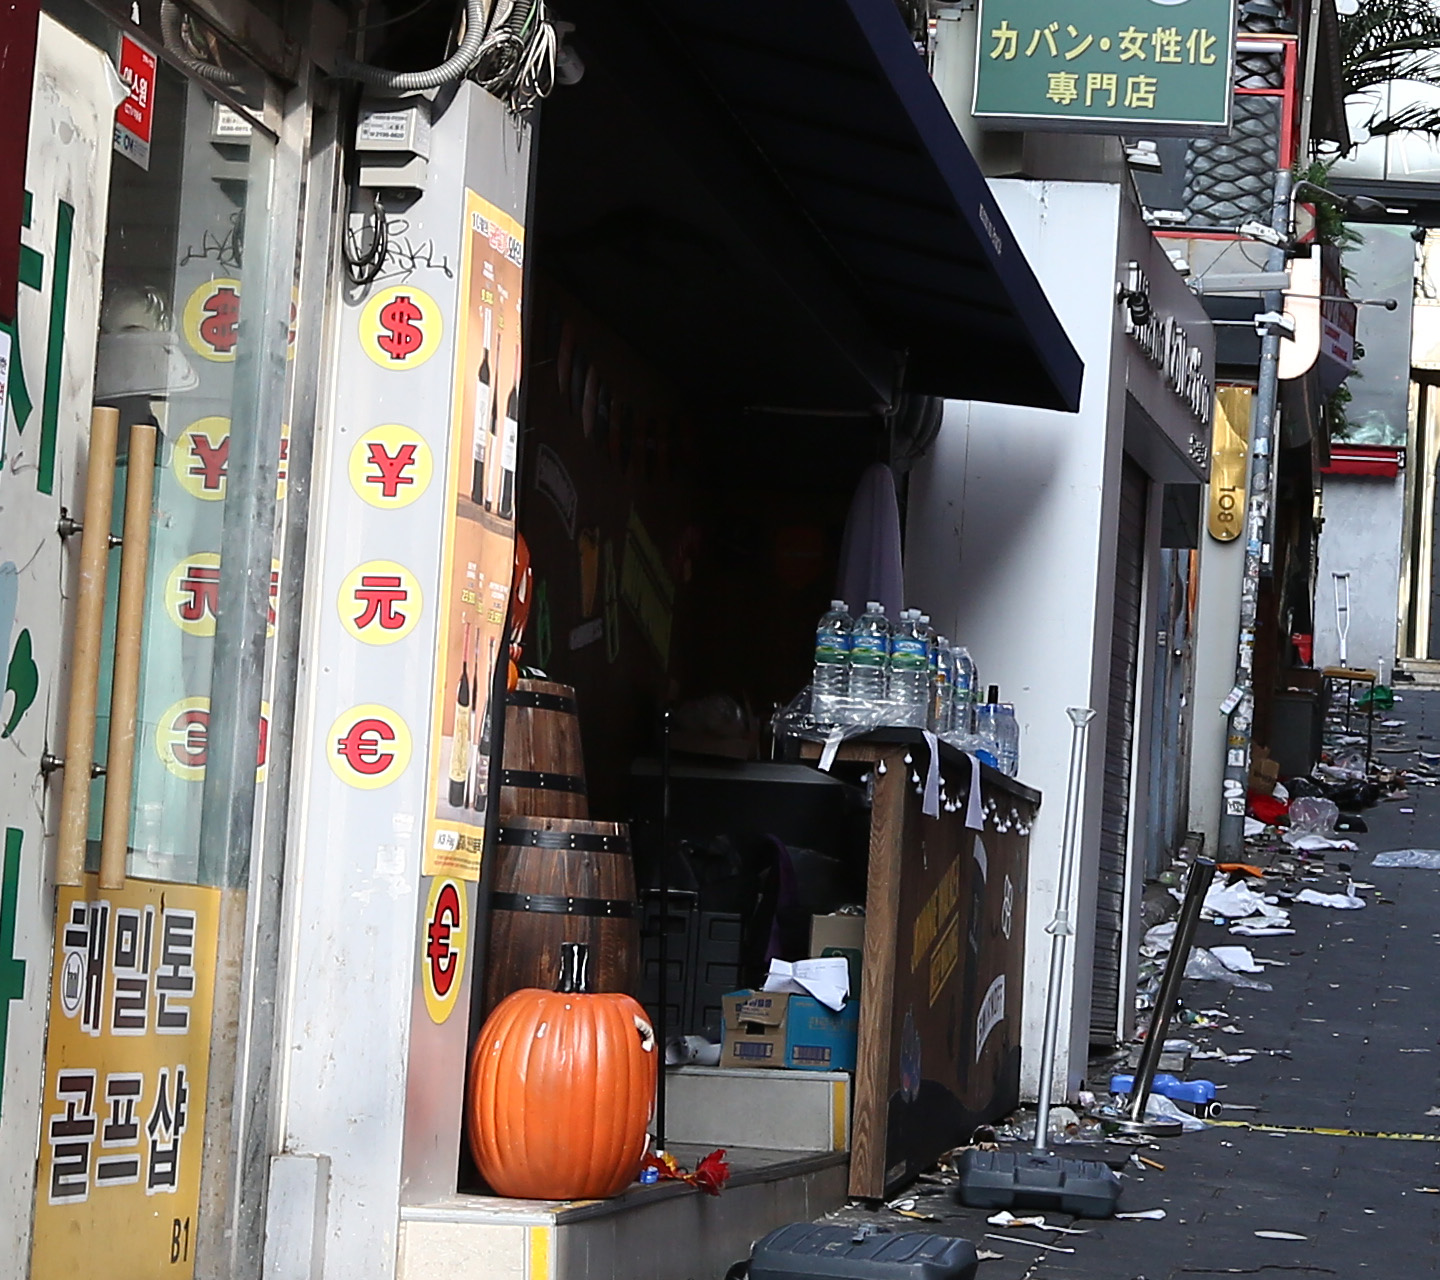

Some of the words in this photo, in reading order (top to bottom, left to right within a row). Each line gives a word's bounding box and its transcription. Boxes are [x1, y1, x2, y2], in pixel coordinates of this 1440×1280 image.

[990, 21, 1218, 66] カバン・女性化
[353, 574, 408, 631] 元
[62, 899, 197, 1037] 해밀톤
[48, 1064, 190, 1206] 골프샵
[170, 1217, 190, 1264] B1
